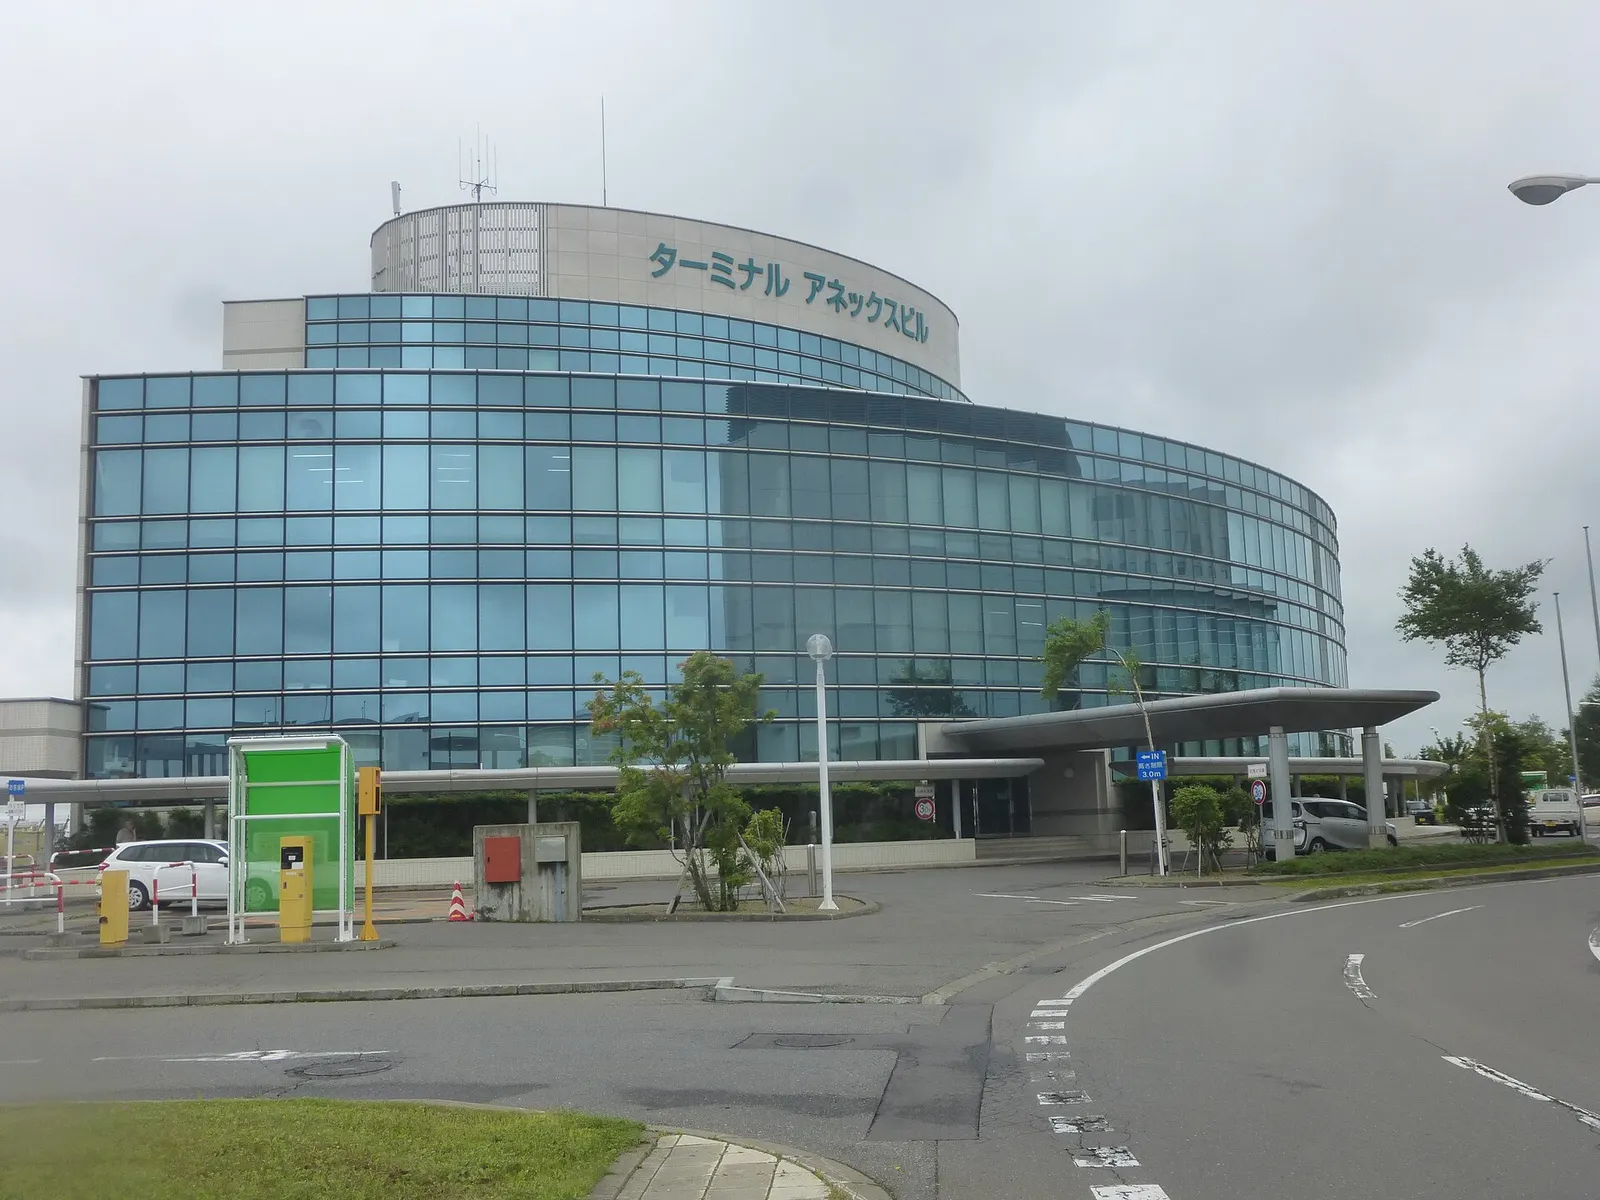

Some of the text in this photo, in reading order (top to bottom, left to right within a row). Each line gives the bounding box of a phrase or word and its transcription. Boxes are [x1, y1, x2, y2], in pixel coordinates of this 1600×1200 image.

[649, 242, 929, 344] ターミナル アネックスビル
